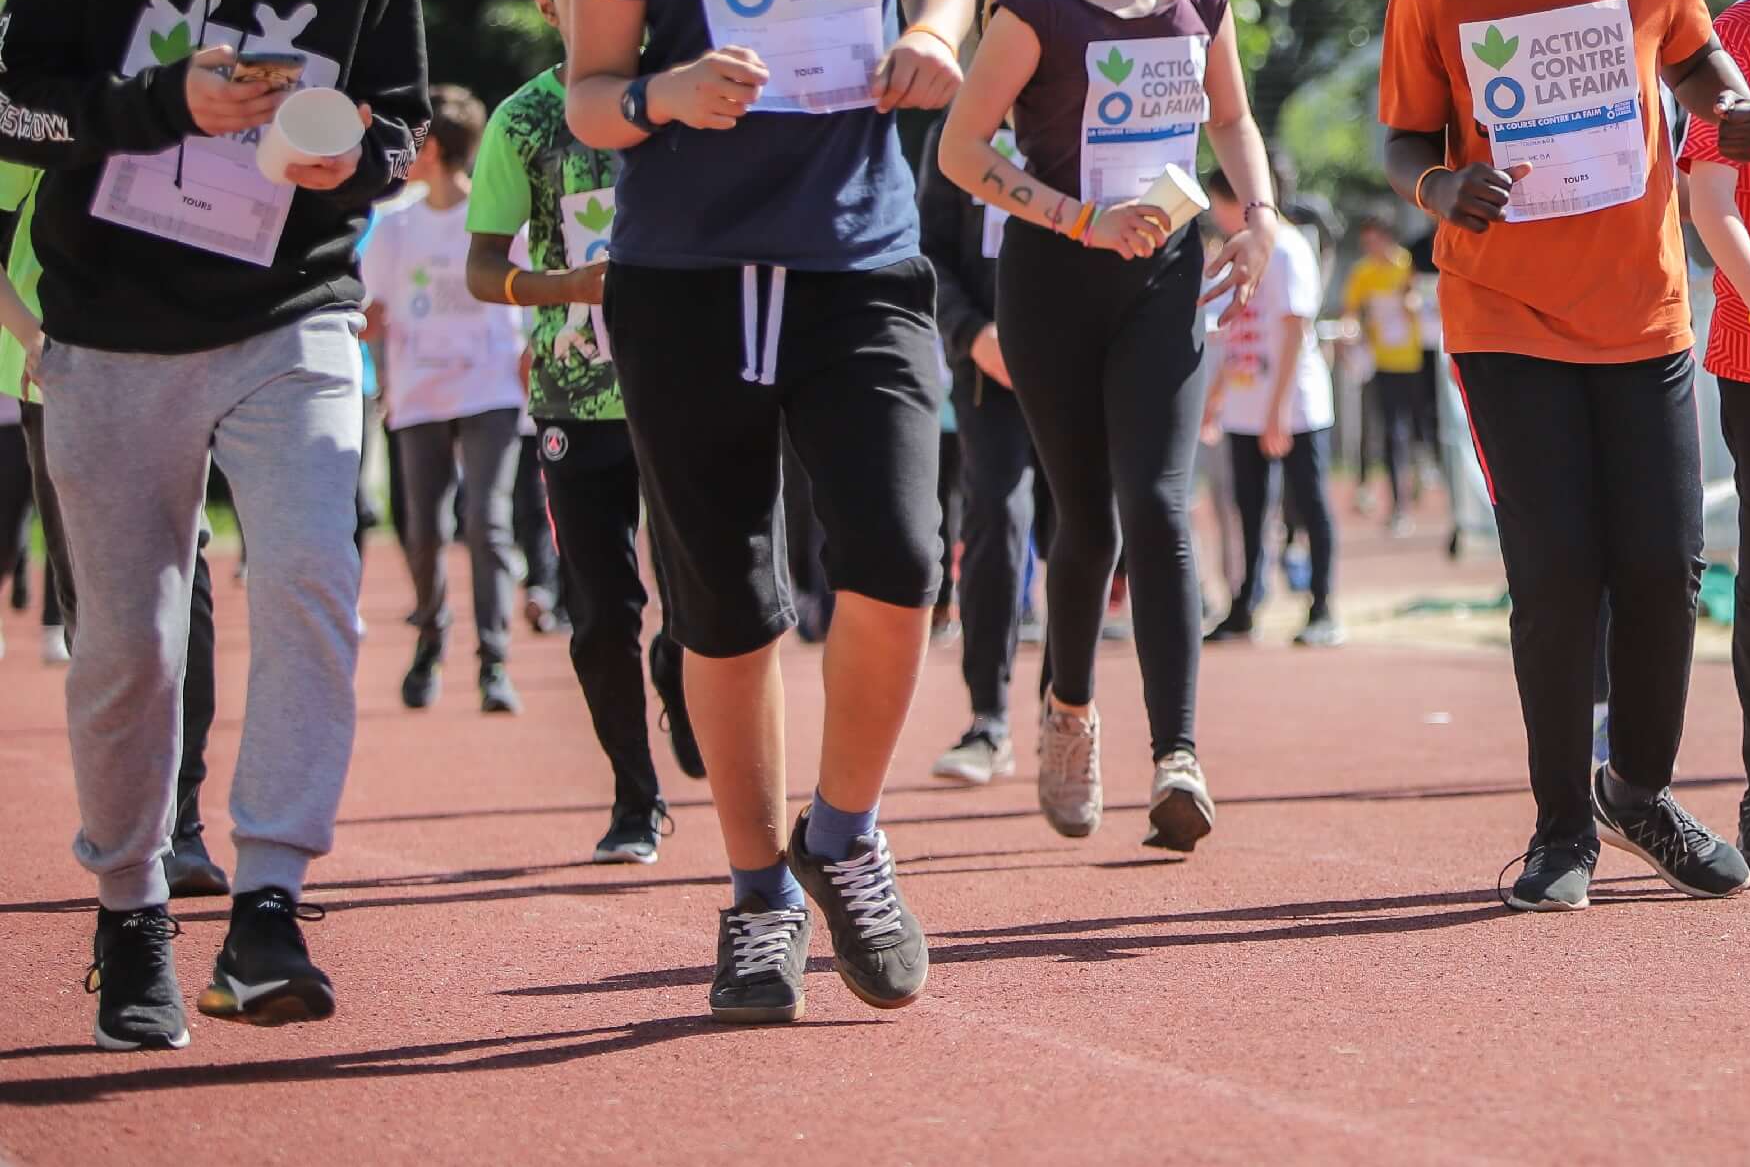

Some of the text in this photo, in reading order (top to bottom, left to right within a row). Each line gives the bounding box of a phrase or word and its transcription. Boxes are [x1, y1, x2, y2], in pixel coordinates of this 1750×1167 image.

[1529, 22, 1624, 59] ACTION
[794, 65, 825, 77] TOURS
[1531, 46, 1626, 81] CONTRE
[1141, 79, 1202, 99] CONTR
[1535, 68, 1629, 105] LA FAIM
[1140, 97, 1204, 118] LA FAIM
[1494, 108, 1602, 132] LA COURSE CONTRE LA FAIM
[1563, 174, 1590, 185] TOURS
[183, 195, 213, 211] TOURS
